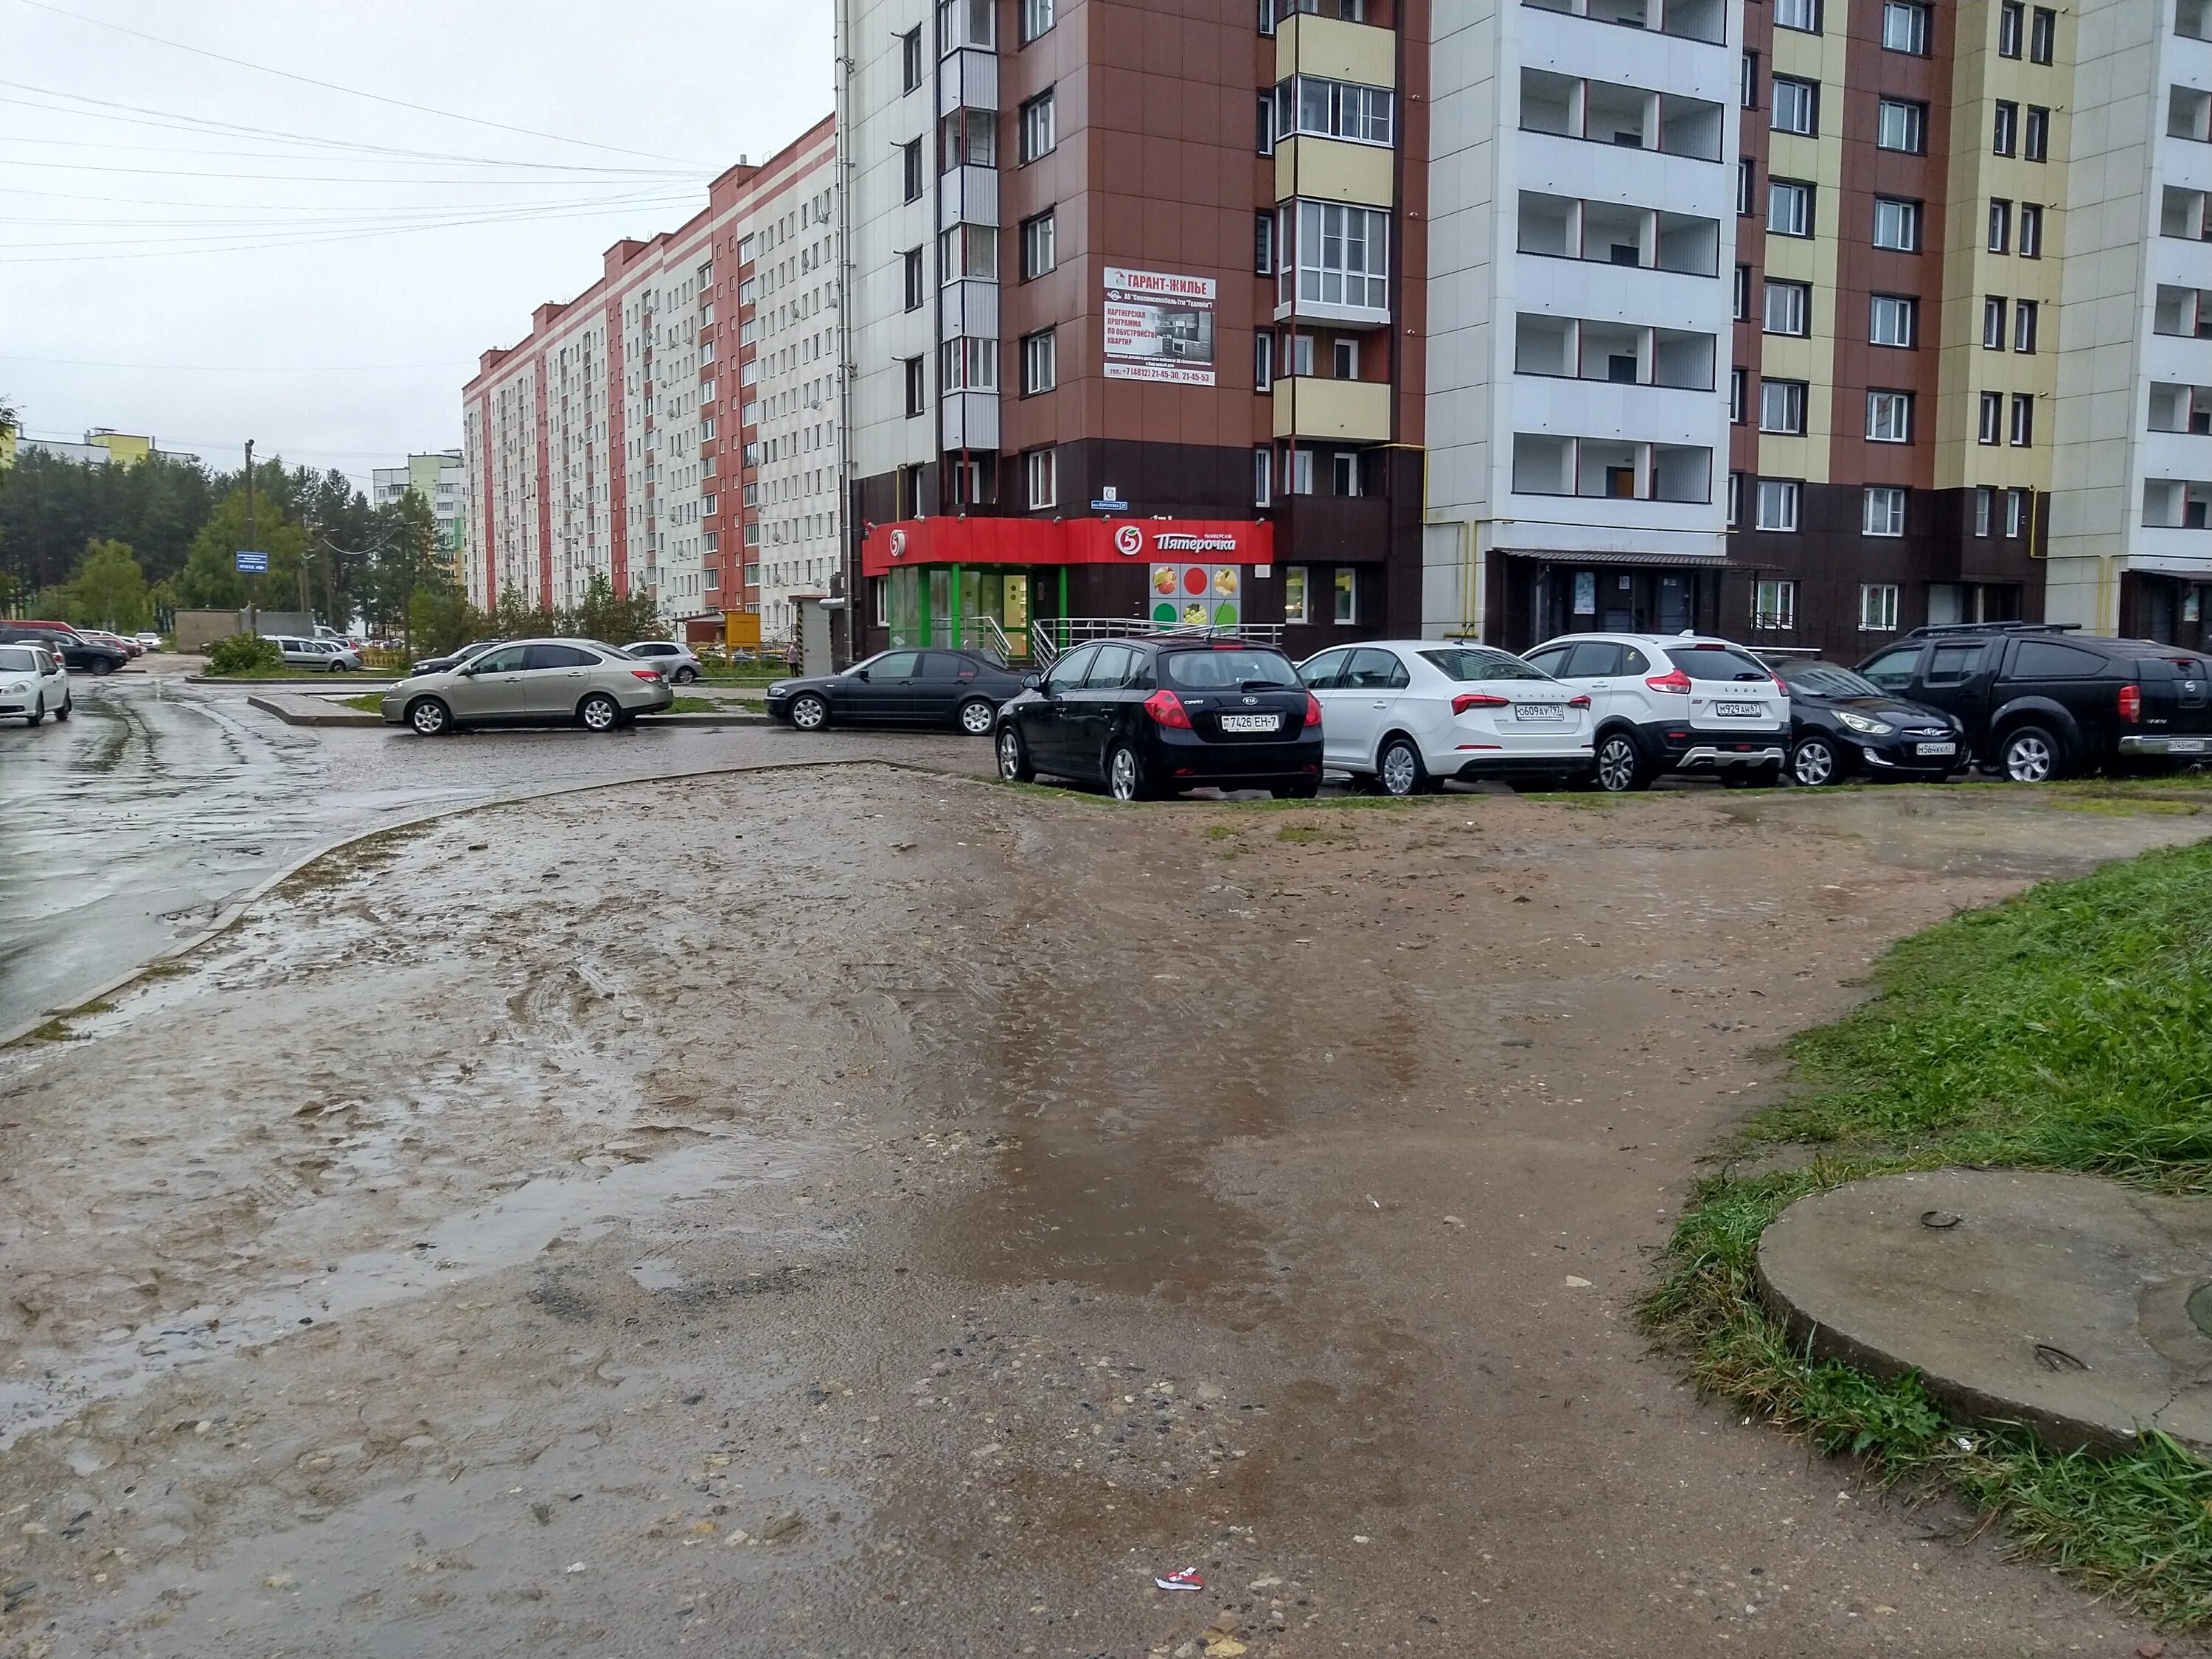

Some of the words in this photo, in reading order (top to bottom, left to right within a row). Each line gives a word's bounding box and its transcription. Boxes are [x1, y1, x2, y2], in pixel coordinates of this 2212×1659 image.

[1127, 274, 1207, 295] ГАРАНТ-ЖИЛЬЕ
[1107, 307, 1146, 319] ПАРТНЕРСКАЯ
[1107, 318, 1141, 327] ПРОГРАММА
[1116, 328, 1158, 338] ОБУСТРОЙСТВУ
[1107, 337, 1133, 346] КВАРТИР
[1130, 368, 1151, 378] (4812)
[1182, 372, 1209, 383] 21-45-53
[1519, 706, 1548, 716] О609АУ
[1548, 706, 1559, 714] 797
[1719, 704, 1750, 714] М929АН
[1231, 717, 1252, 728] 7426
[1254, 717, 1276, 727] EH-7
[1918, 745, 1944, 754] М564КК
